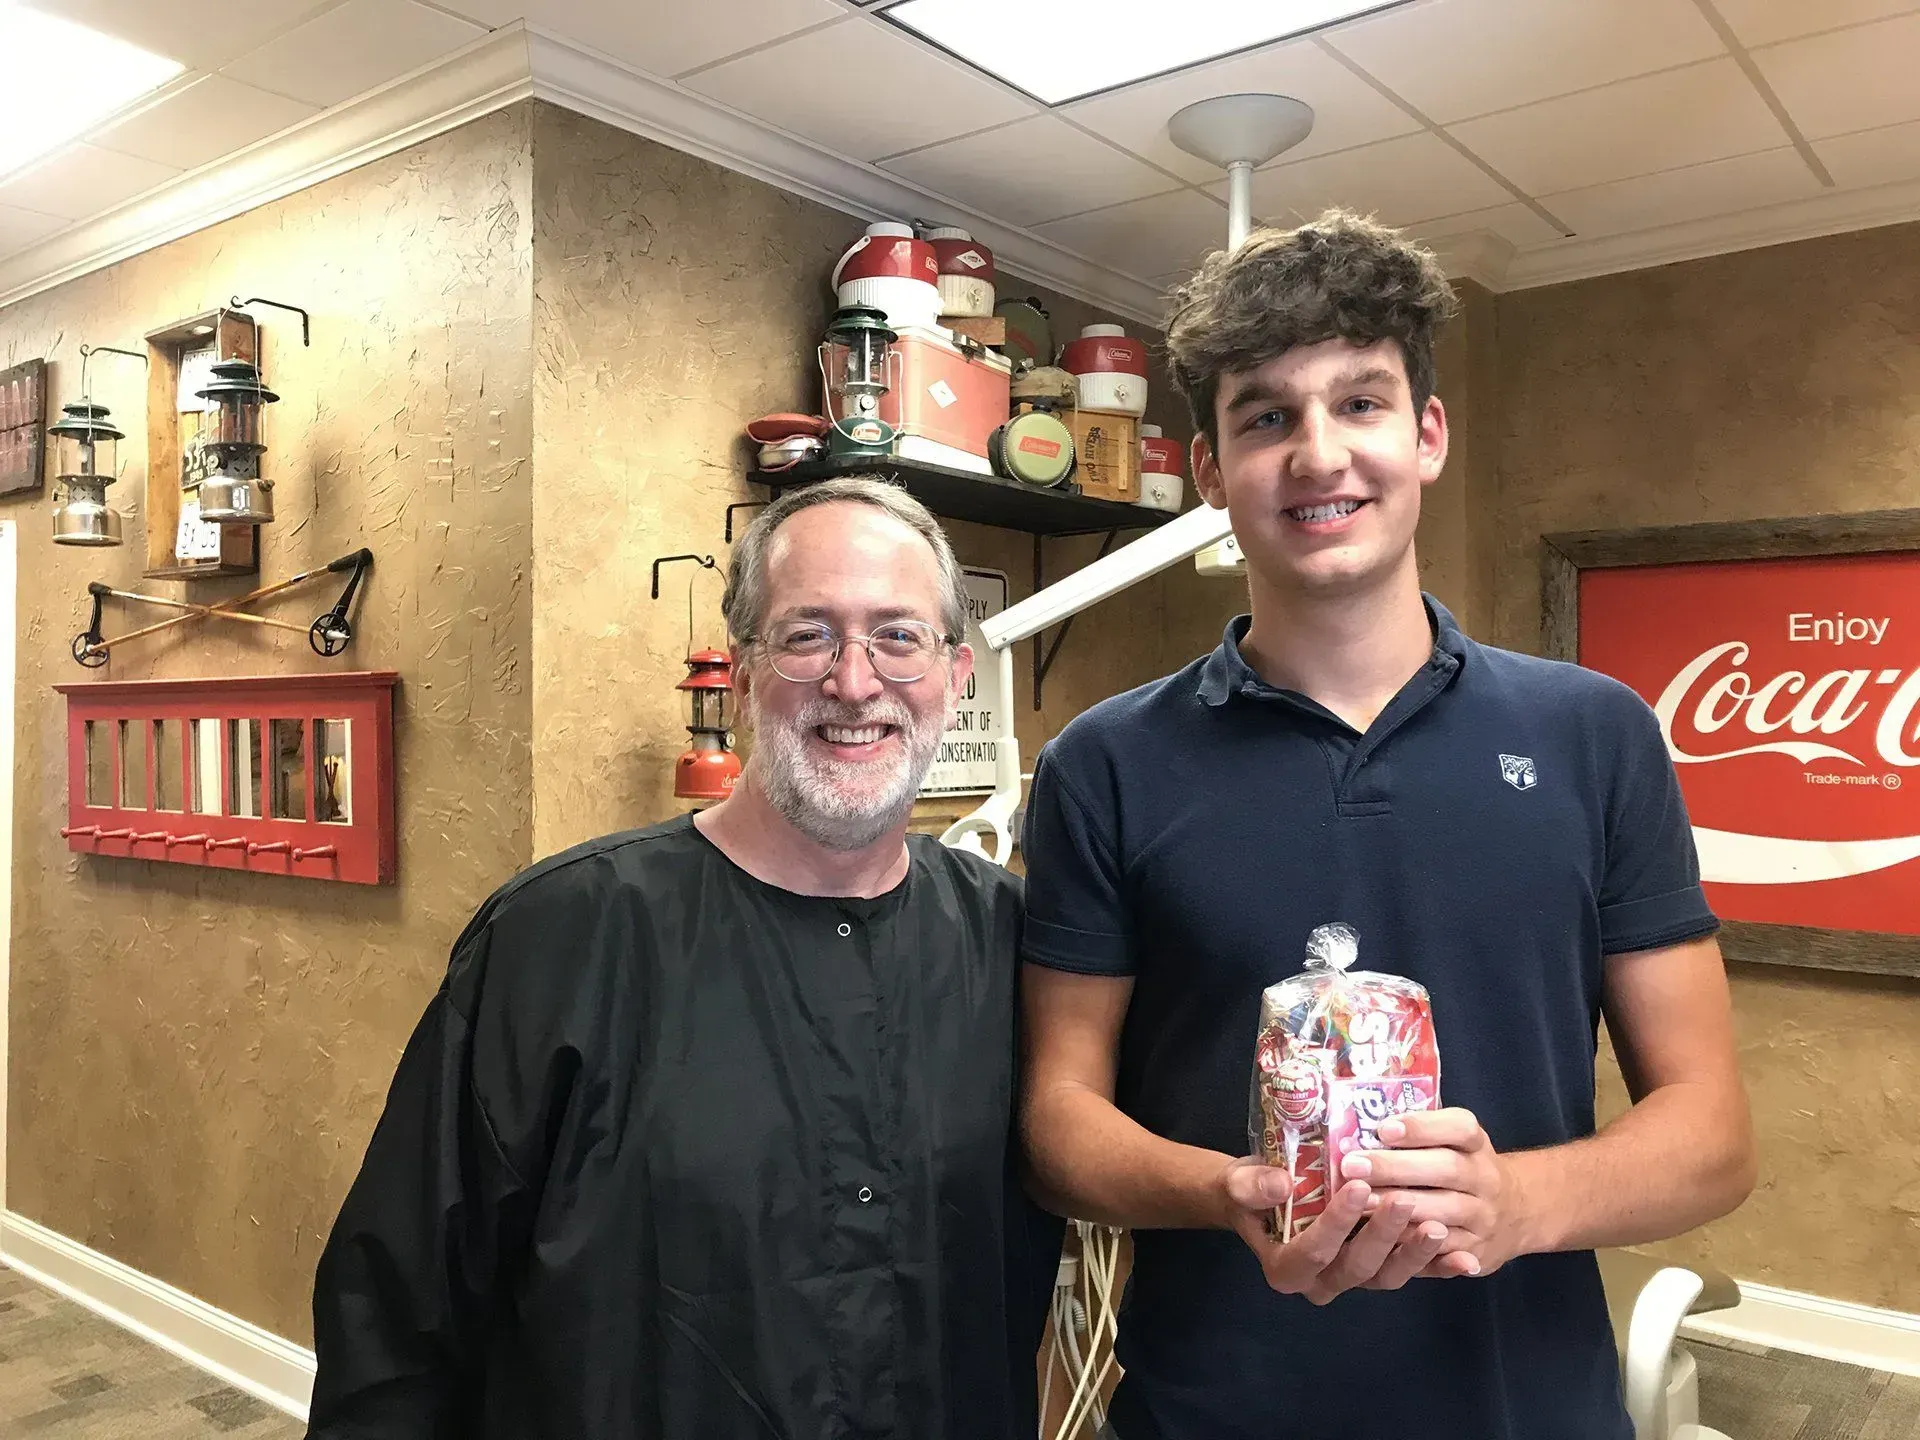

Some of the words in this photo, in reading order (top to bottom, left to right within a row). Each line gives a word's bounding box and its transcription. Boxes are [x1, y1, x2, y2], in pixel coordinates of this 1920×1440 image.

[1084, 426, 1101, 460] RIVERS
[1085, 462, 1100, 484] TWO
[1787, 612, 1890, 646] Enjoy
[953, 710, 974, 732] ENT
[979, 710, 992, 732] OF
[1803, 772, 1880, 786] Trade-mark
